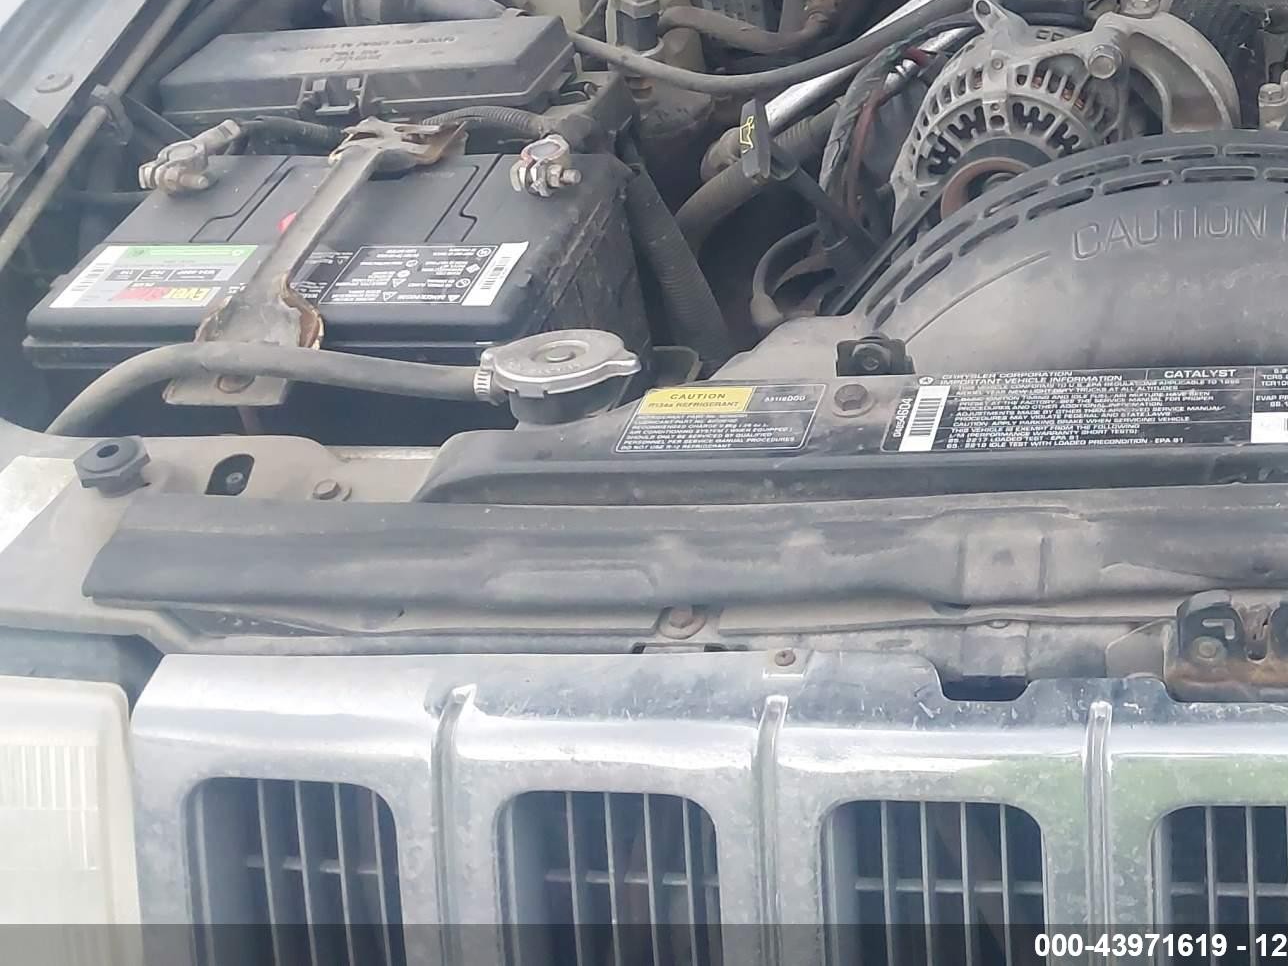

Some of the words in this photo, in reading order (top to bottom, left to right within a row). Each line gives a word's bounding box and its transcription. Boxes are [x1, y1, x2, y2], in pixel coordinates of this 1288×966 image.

[1071, 204, 1268, 261] CAUTION
[1000, 371, 1072, 379] CORPORATION
[1164, 369, 1237, 379] CATALYST
[940, 378, 1001, 386] IMPORTANT
[1050, 375, 1122, 383] INFORMATION
